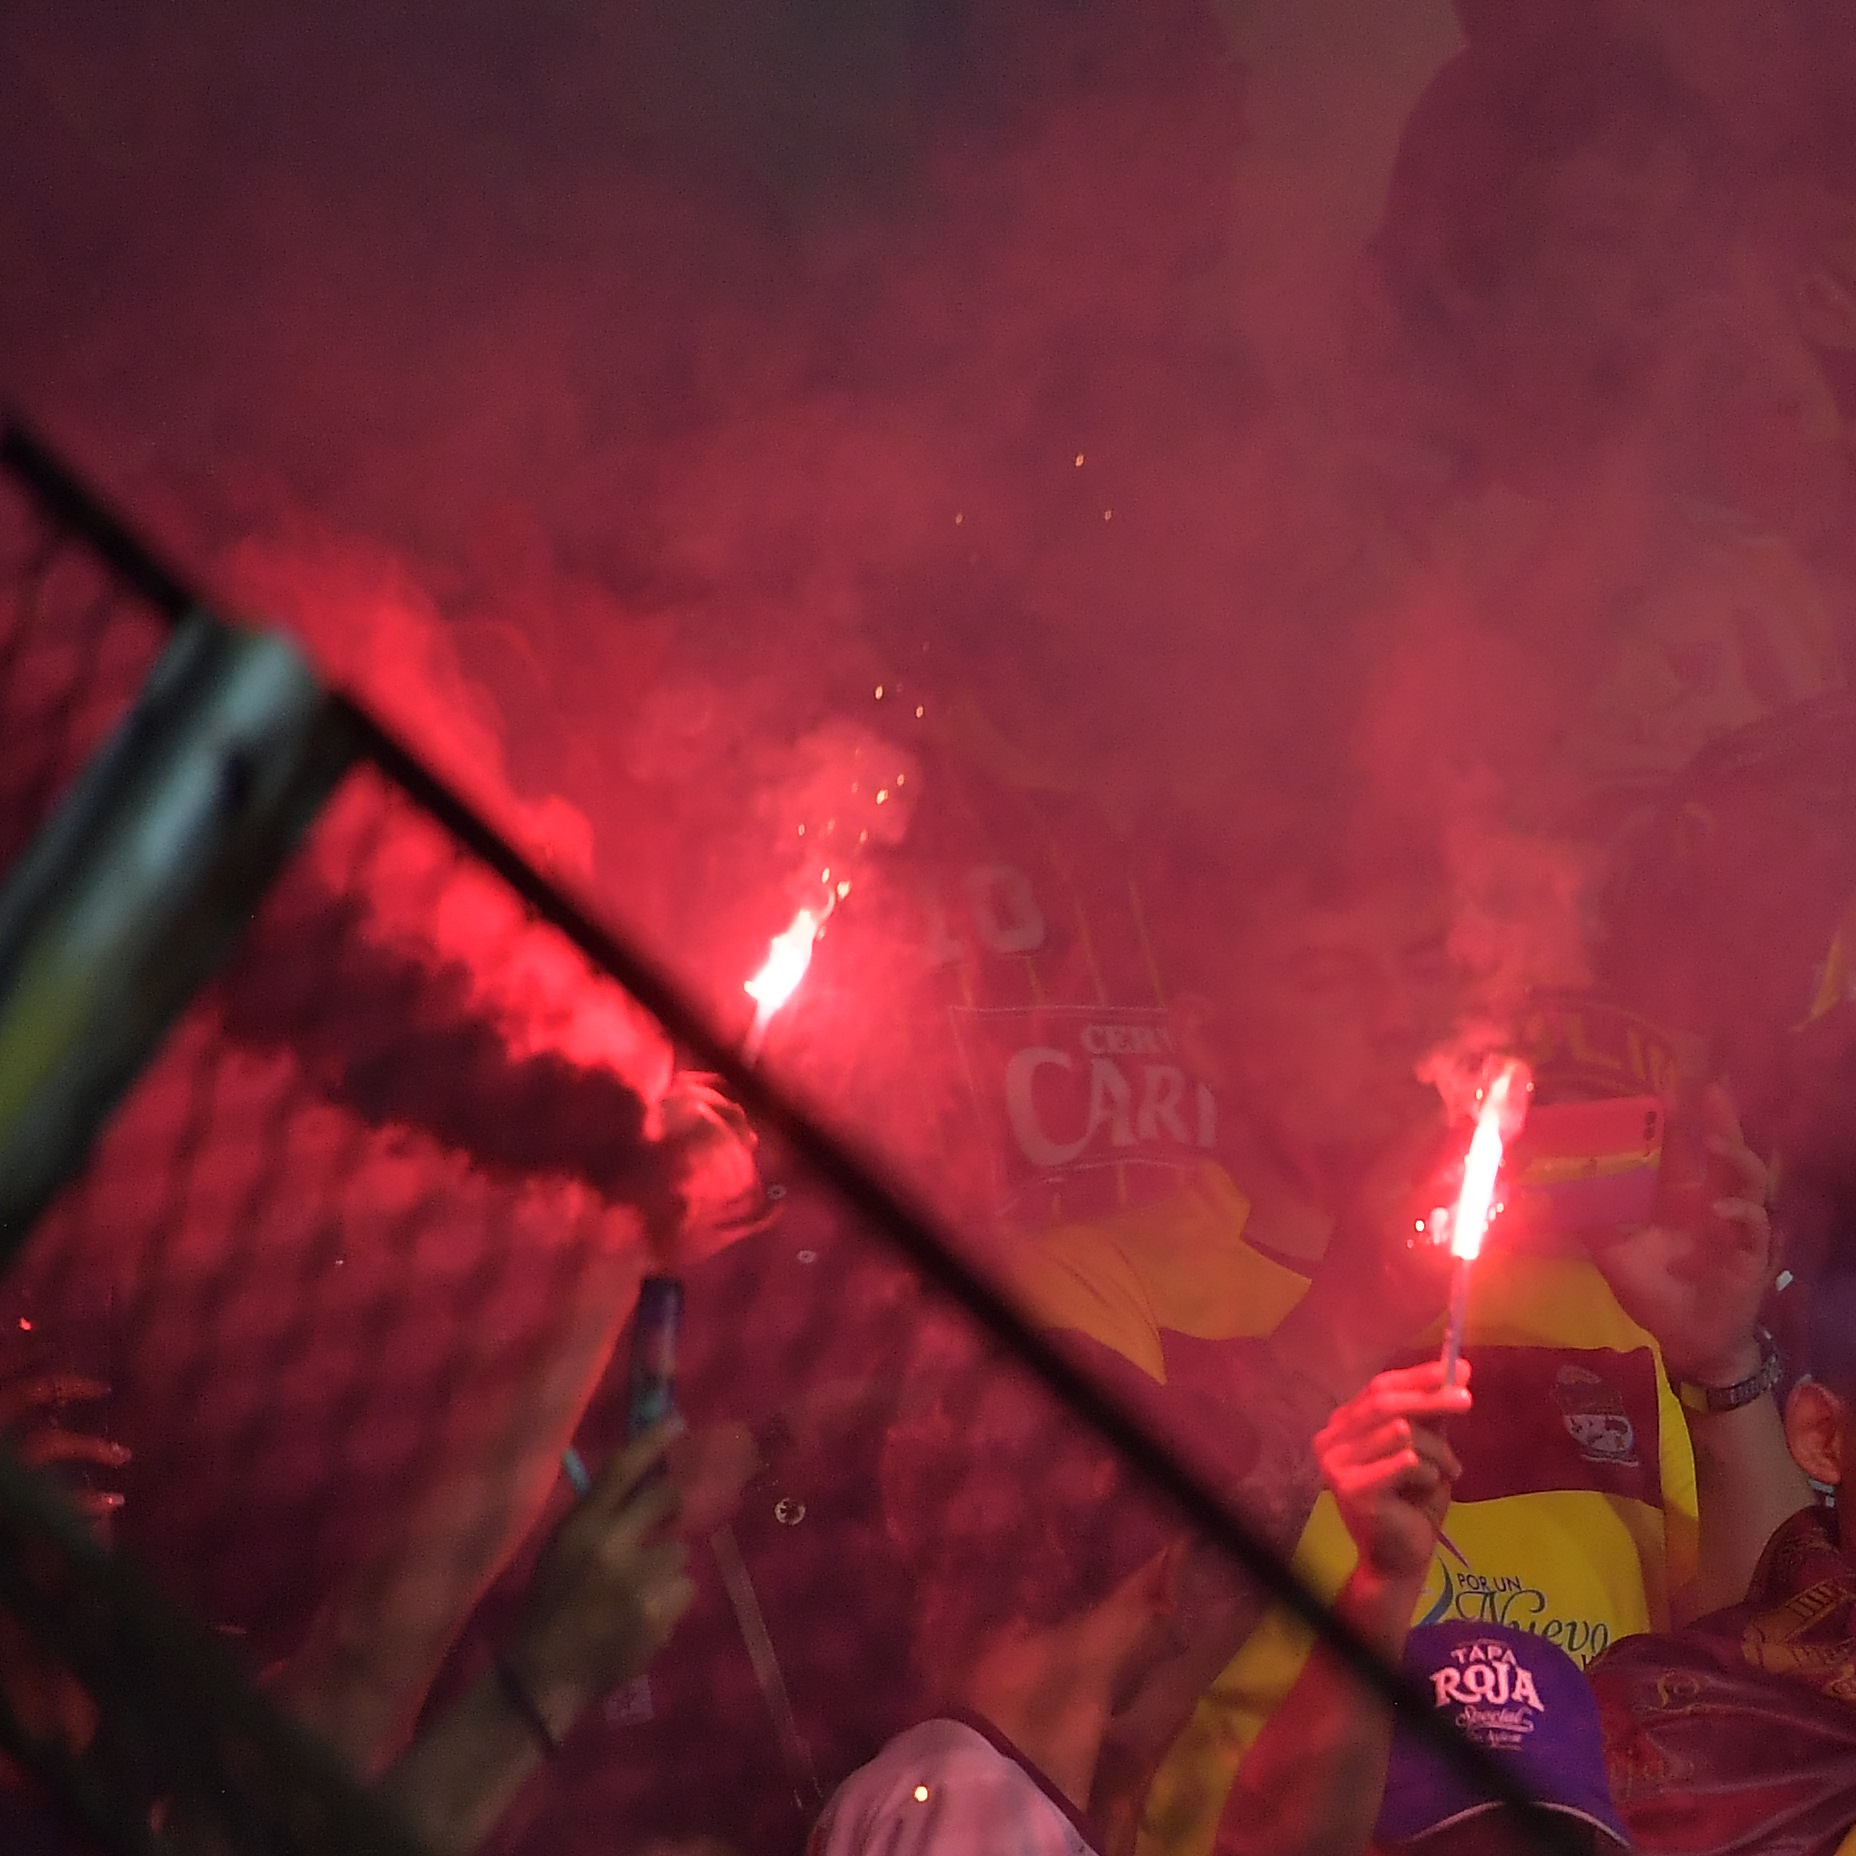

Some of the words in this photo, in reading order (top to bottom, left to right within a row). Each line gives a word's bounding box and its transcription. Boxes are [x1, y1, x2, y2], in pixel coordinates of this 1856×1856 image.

[1457, 1573, 1489, 1592] POR
[1493, 1576, 1522, 1593] UN
[1451, 1644, 1517, 1666] TAPA
[1429, 1661, 1546, 1713] ROJA
